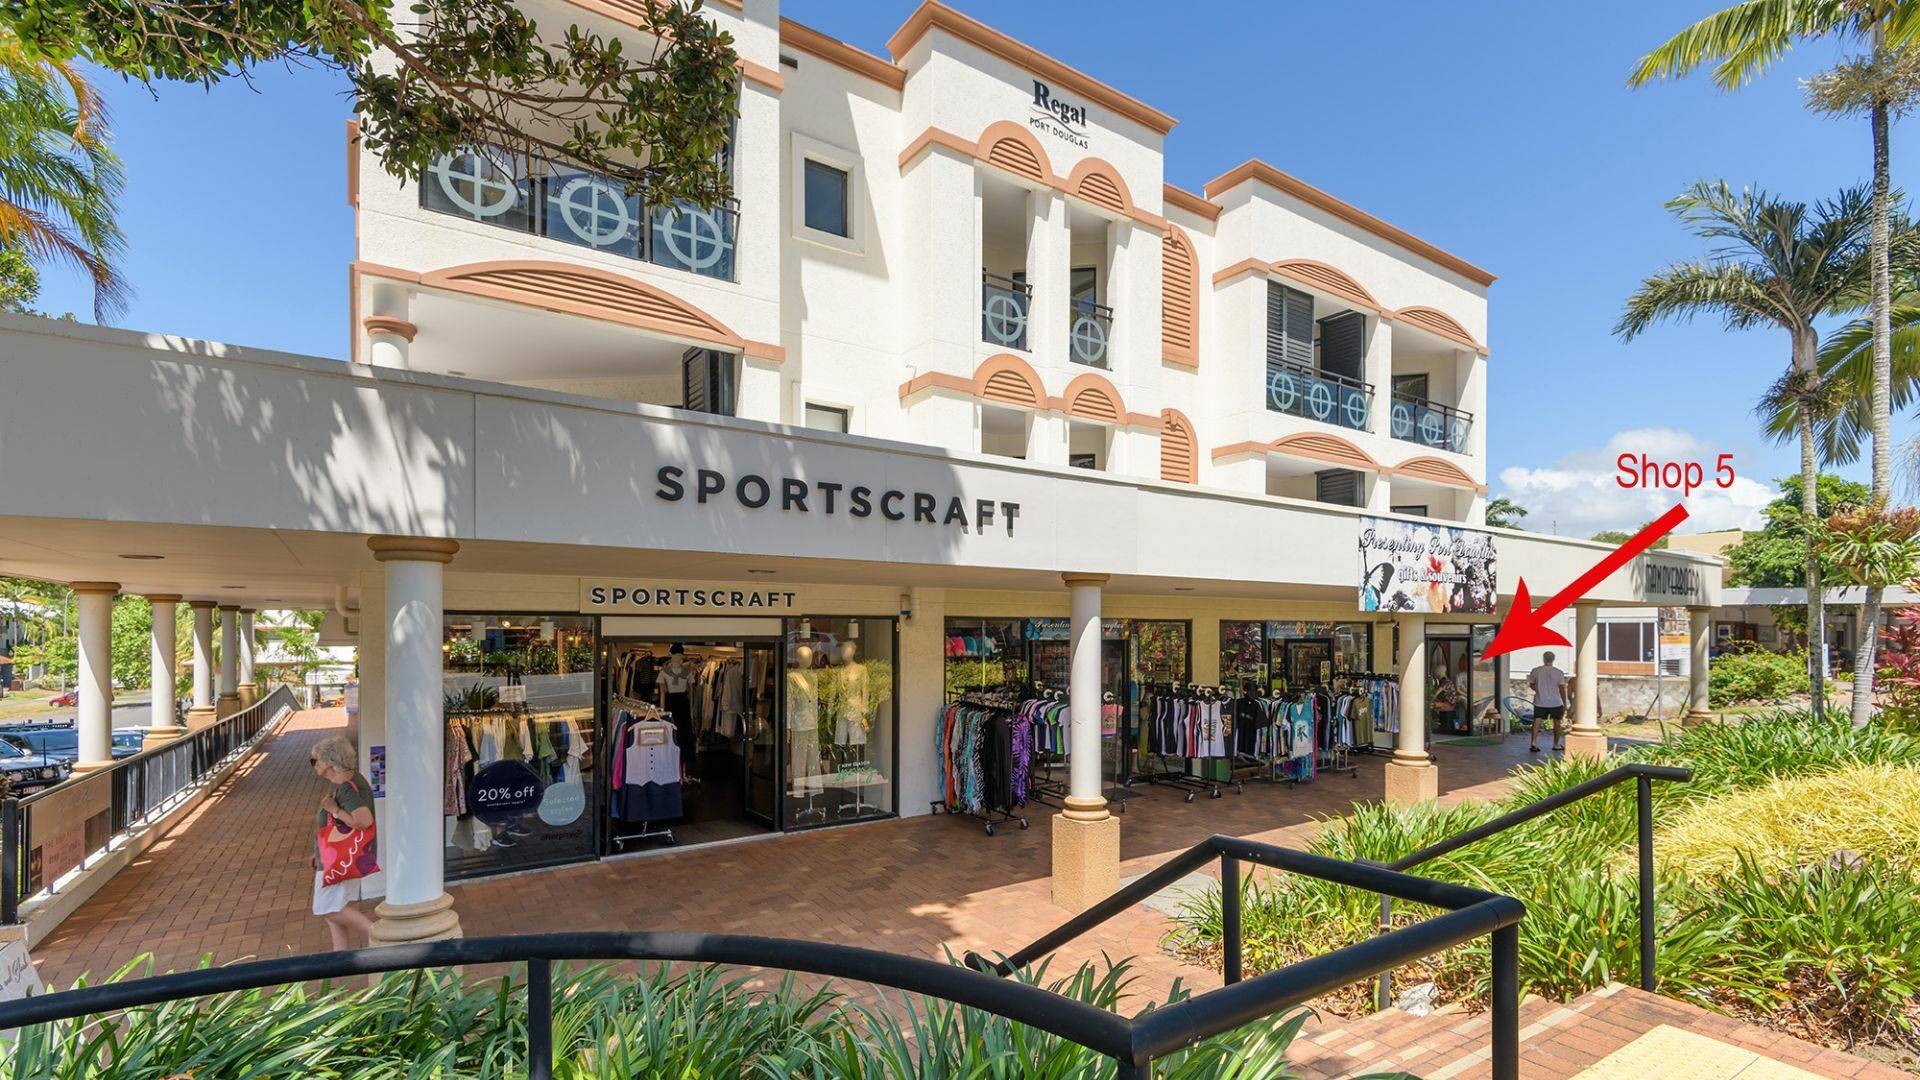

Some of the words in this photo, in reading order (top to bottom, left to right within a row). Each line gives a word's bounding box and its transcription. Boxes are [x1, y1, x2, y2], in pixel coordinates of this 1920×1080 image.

[1032, 79, 1087, 128] Regal
[1029, 117, 1051, 133] PORT
[1052, 127, 1089, 150] DOUGLAS
[655, 465, 1021, 532] SPORTSCRAFT
[1361, 528, 1426, 561] Presenting
[1428, 535, 1453, 557] Port
[1397, 566, 1419, 584] gifts
[1419, 571, 1428, 583] &
[1427, 570, 1468, 585] souvenirs
[590, 586, 797, 608] SPORTSCRAFT
[1034, 620, 1071, 631] Presentin
[477, 787, 512, 803] 20%
[514, 785, 535, 799] off
